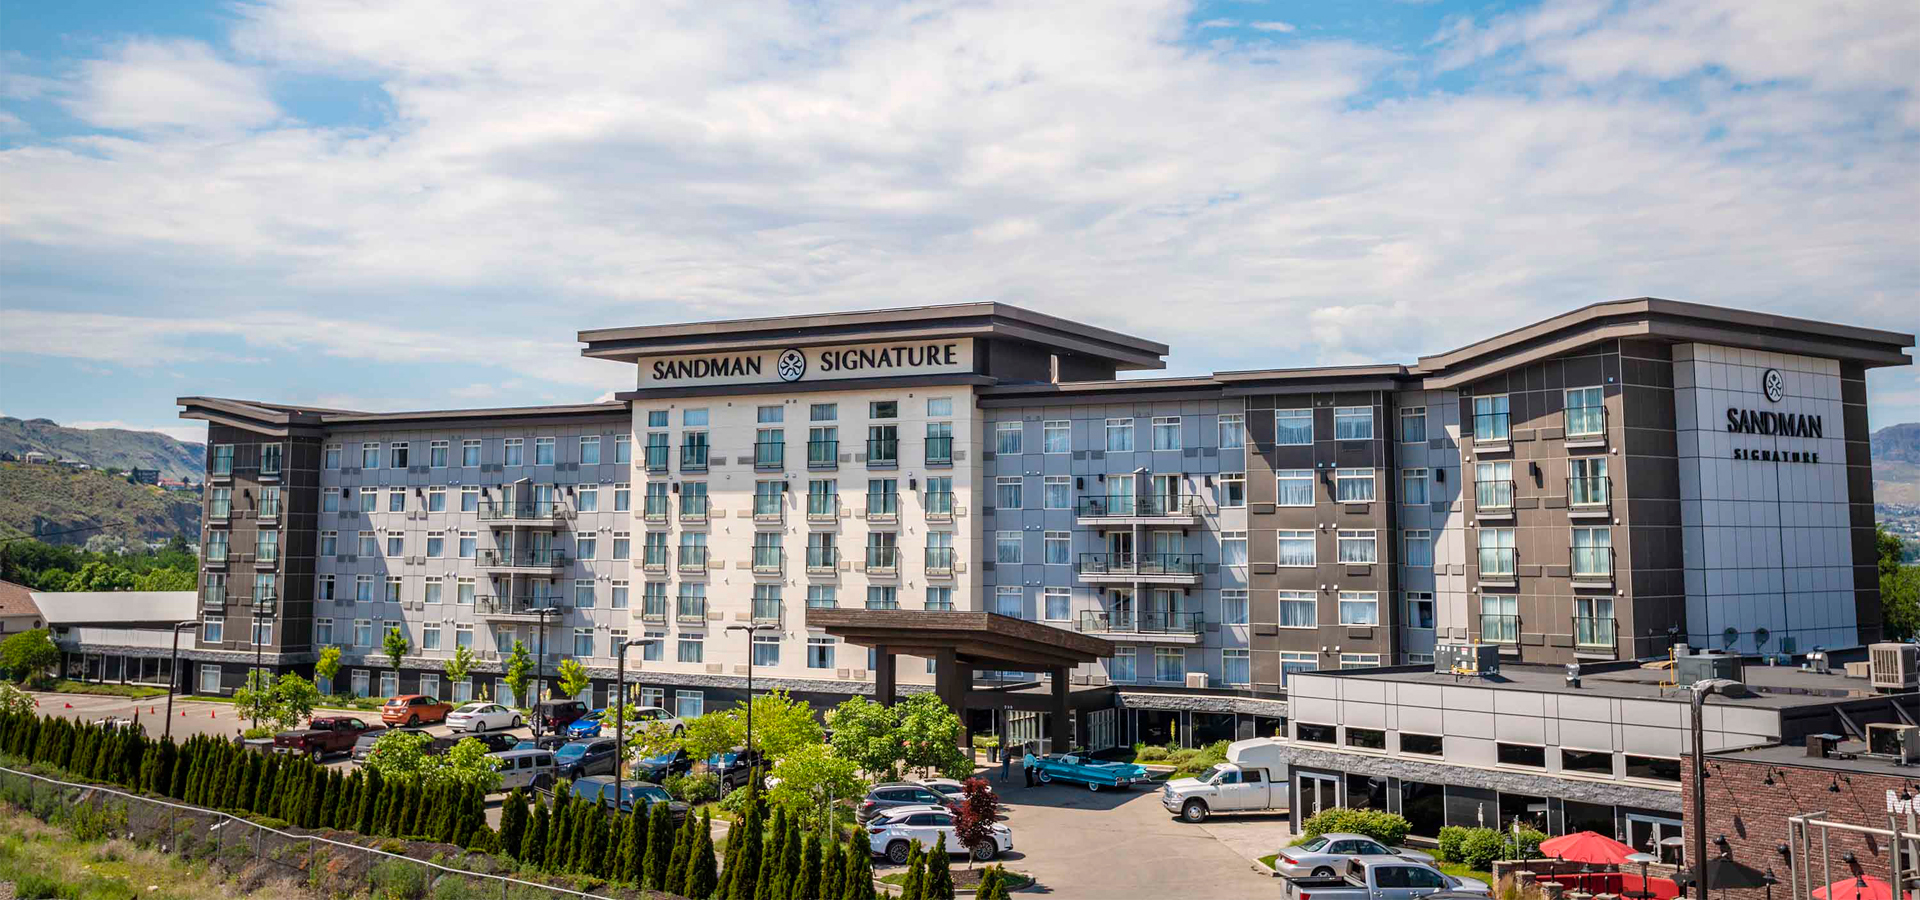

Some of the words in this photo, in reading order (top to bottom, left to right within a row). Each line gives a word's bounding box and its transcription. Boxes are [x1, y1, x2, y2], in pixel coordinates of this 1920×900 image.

[652, 356, 761, 380] SANDMAN
[820, 344, 958, 372] SIGNATURE
[1727, 407, 1822, 438] SANDMAN
[1734, 448, 1820, 463] SIGNATURE
